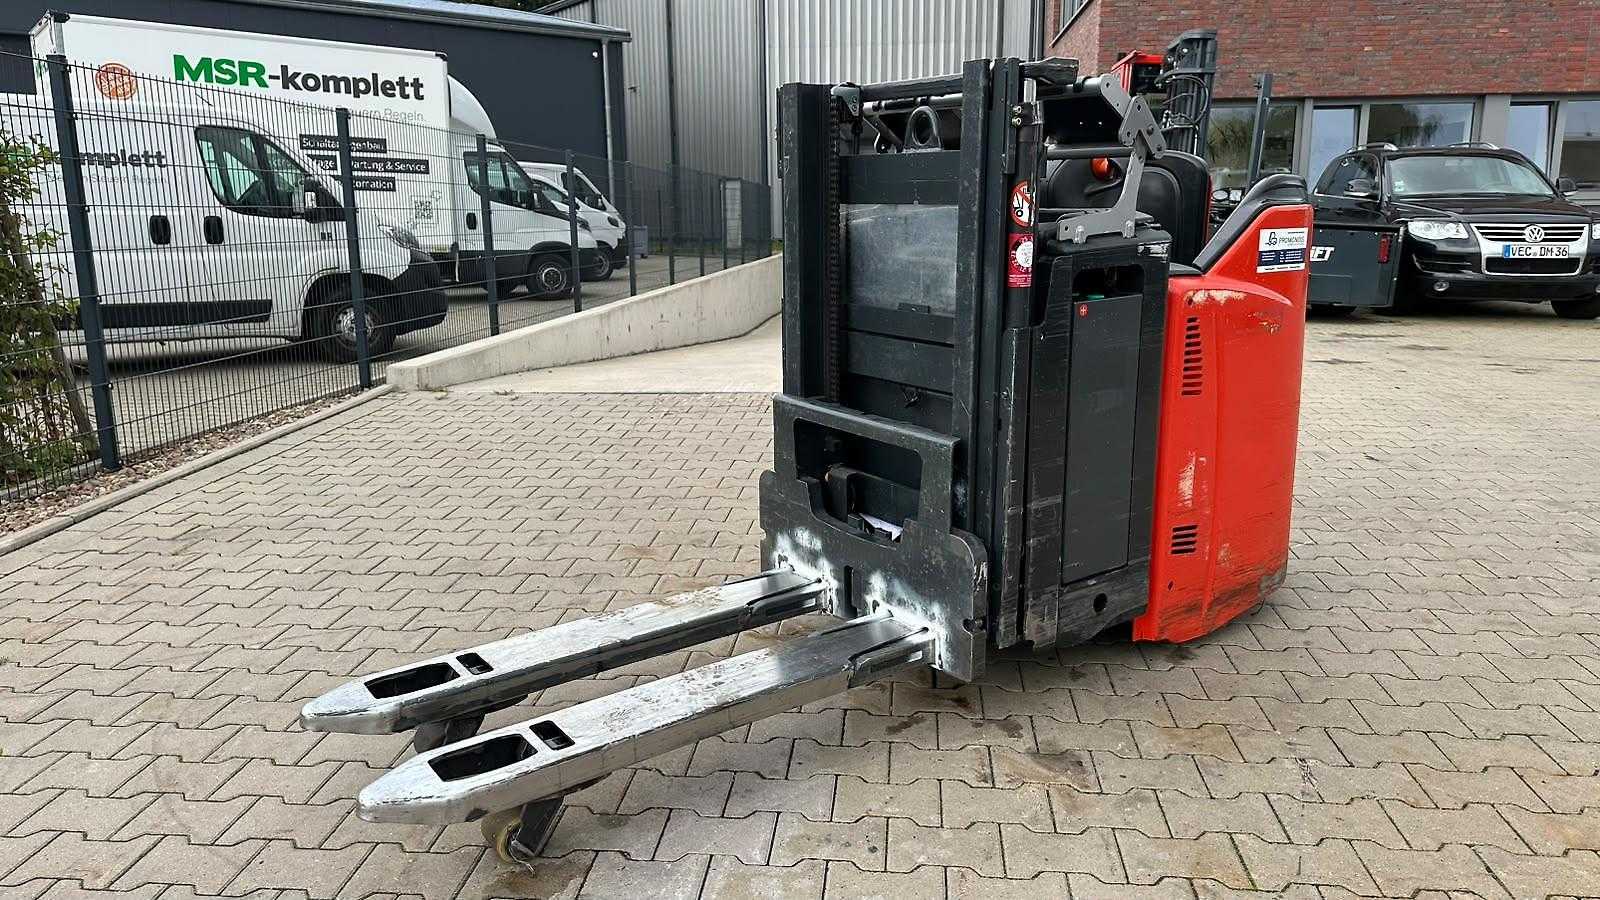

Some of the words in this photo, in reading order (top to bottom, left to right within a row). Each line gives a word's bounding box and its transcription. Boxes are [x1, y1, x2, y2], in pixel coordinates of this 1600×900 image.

[172, 54, 424, 101] MSR-komplett
[395, 161, 426, 171] Service
[1511, 246, 1532, 257] VEC
[1555, 246, 1568, 257] 36
